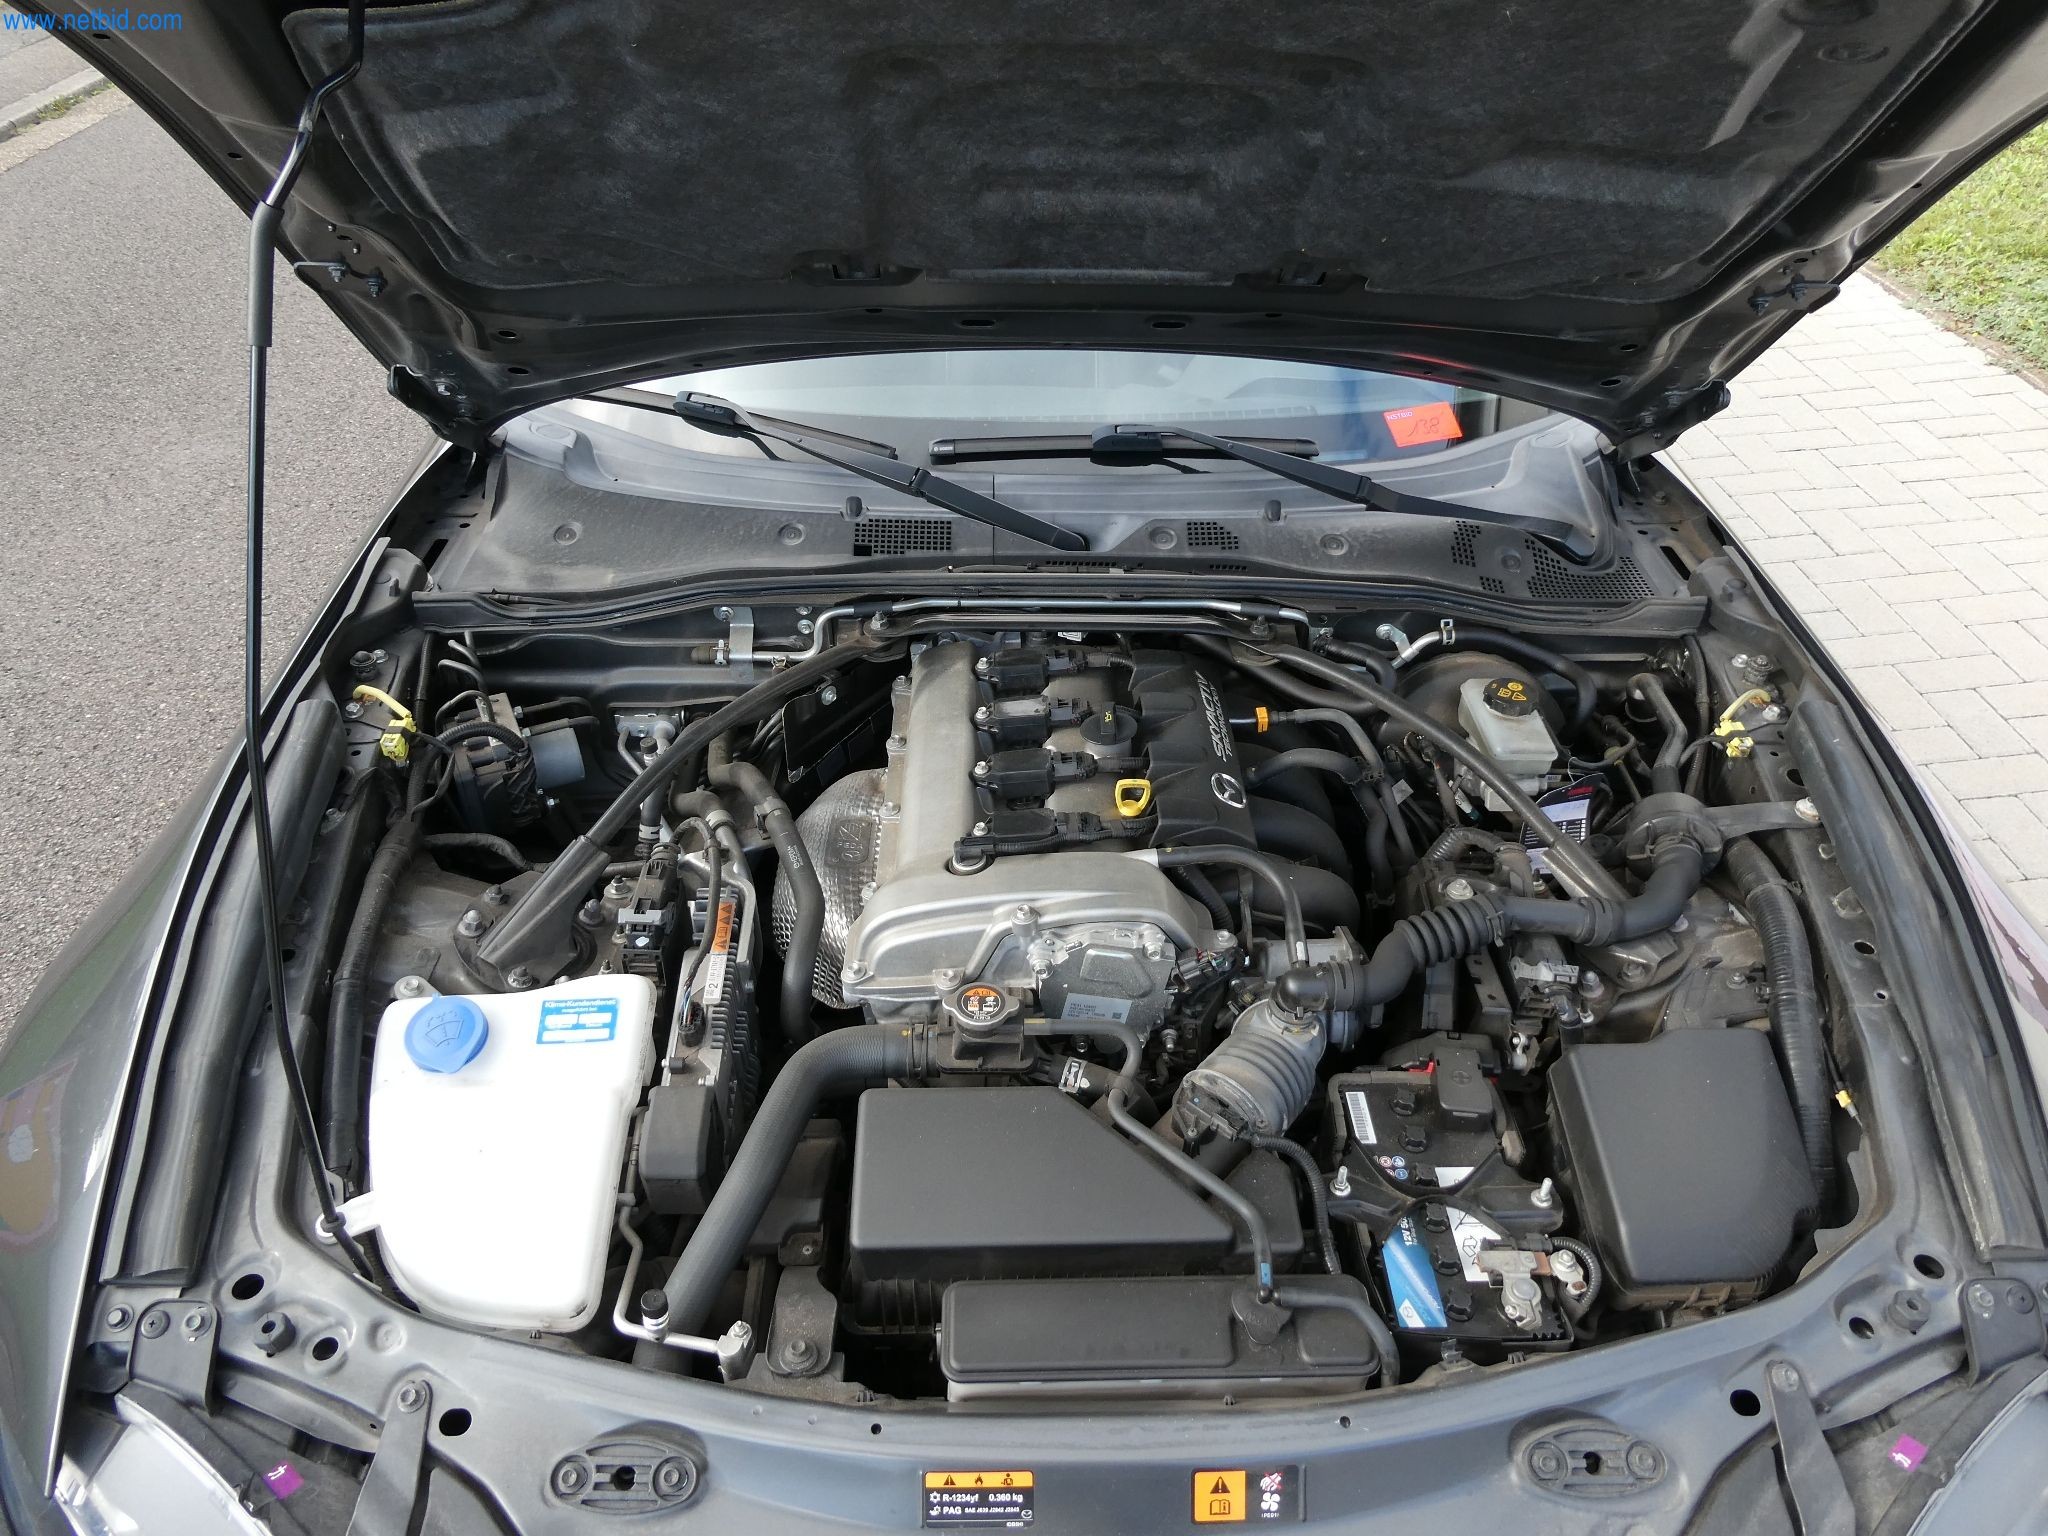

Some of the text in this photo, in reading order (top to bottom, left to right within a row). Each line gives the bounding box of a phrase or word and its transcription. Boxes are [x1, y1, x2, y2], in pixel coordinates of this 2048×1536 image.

[1195, 670, 1227, 762] SKYACTIV
[942, 1493, 979, 1503] R-1234yf
[1012, 1493, 1024, 1503] kg
[943, 1506, 962, 1514] PAG
